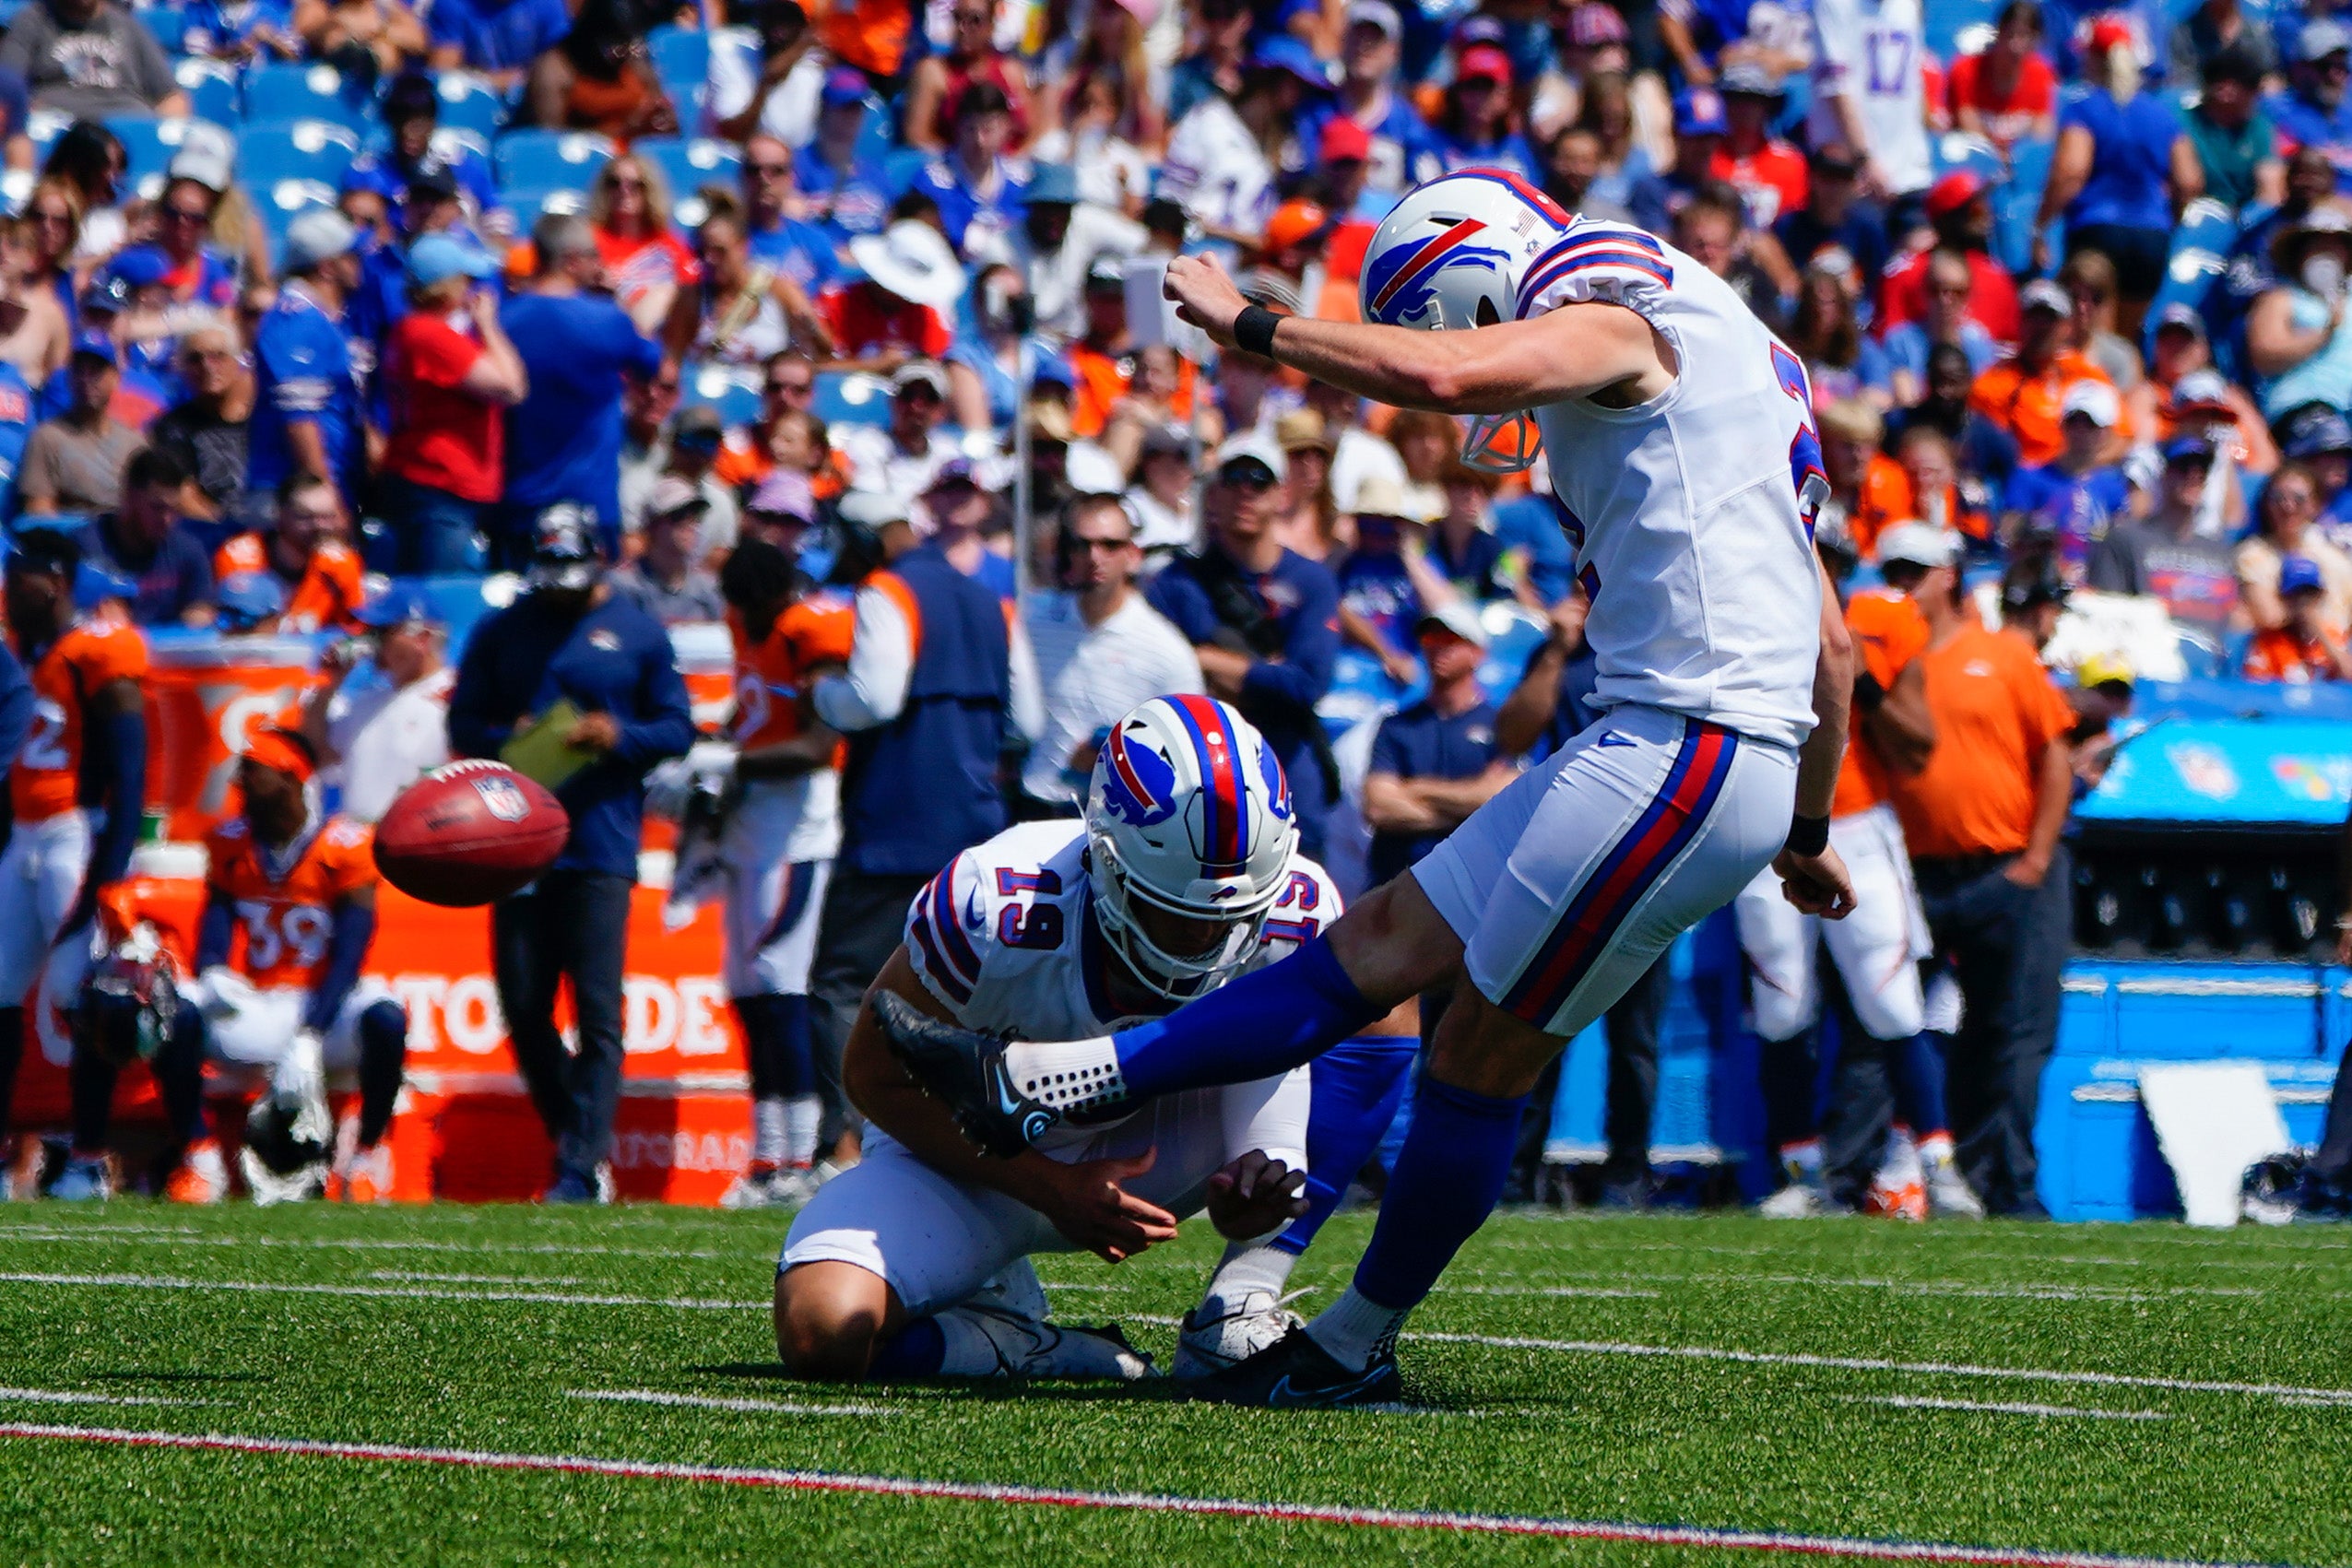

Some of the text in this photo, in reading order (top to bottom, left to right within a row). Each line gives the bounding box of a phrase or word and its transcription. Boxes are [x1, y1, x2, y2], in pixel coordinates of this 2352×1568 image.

[1862, 29, 1913, 96] 17
[233, 898, 334, 970] 39
[995, 867, 1064, 950] 19
